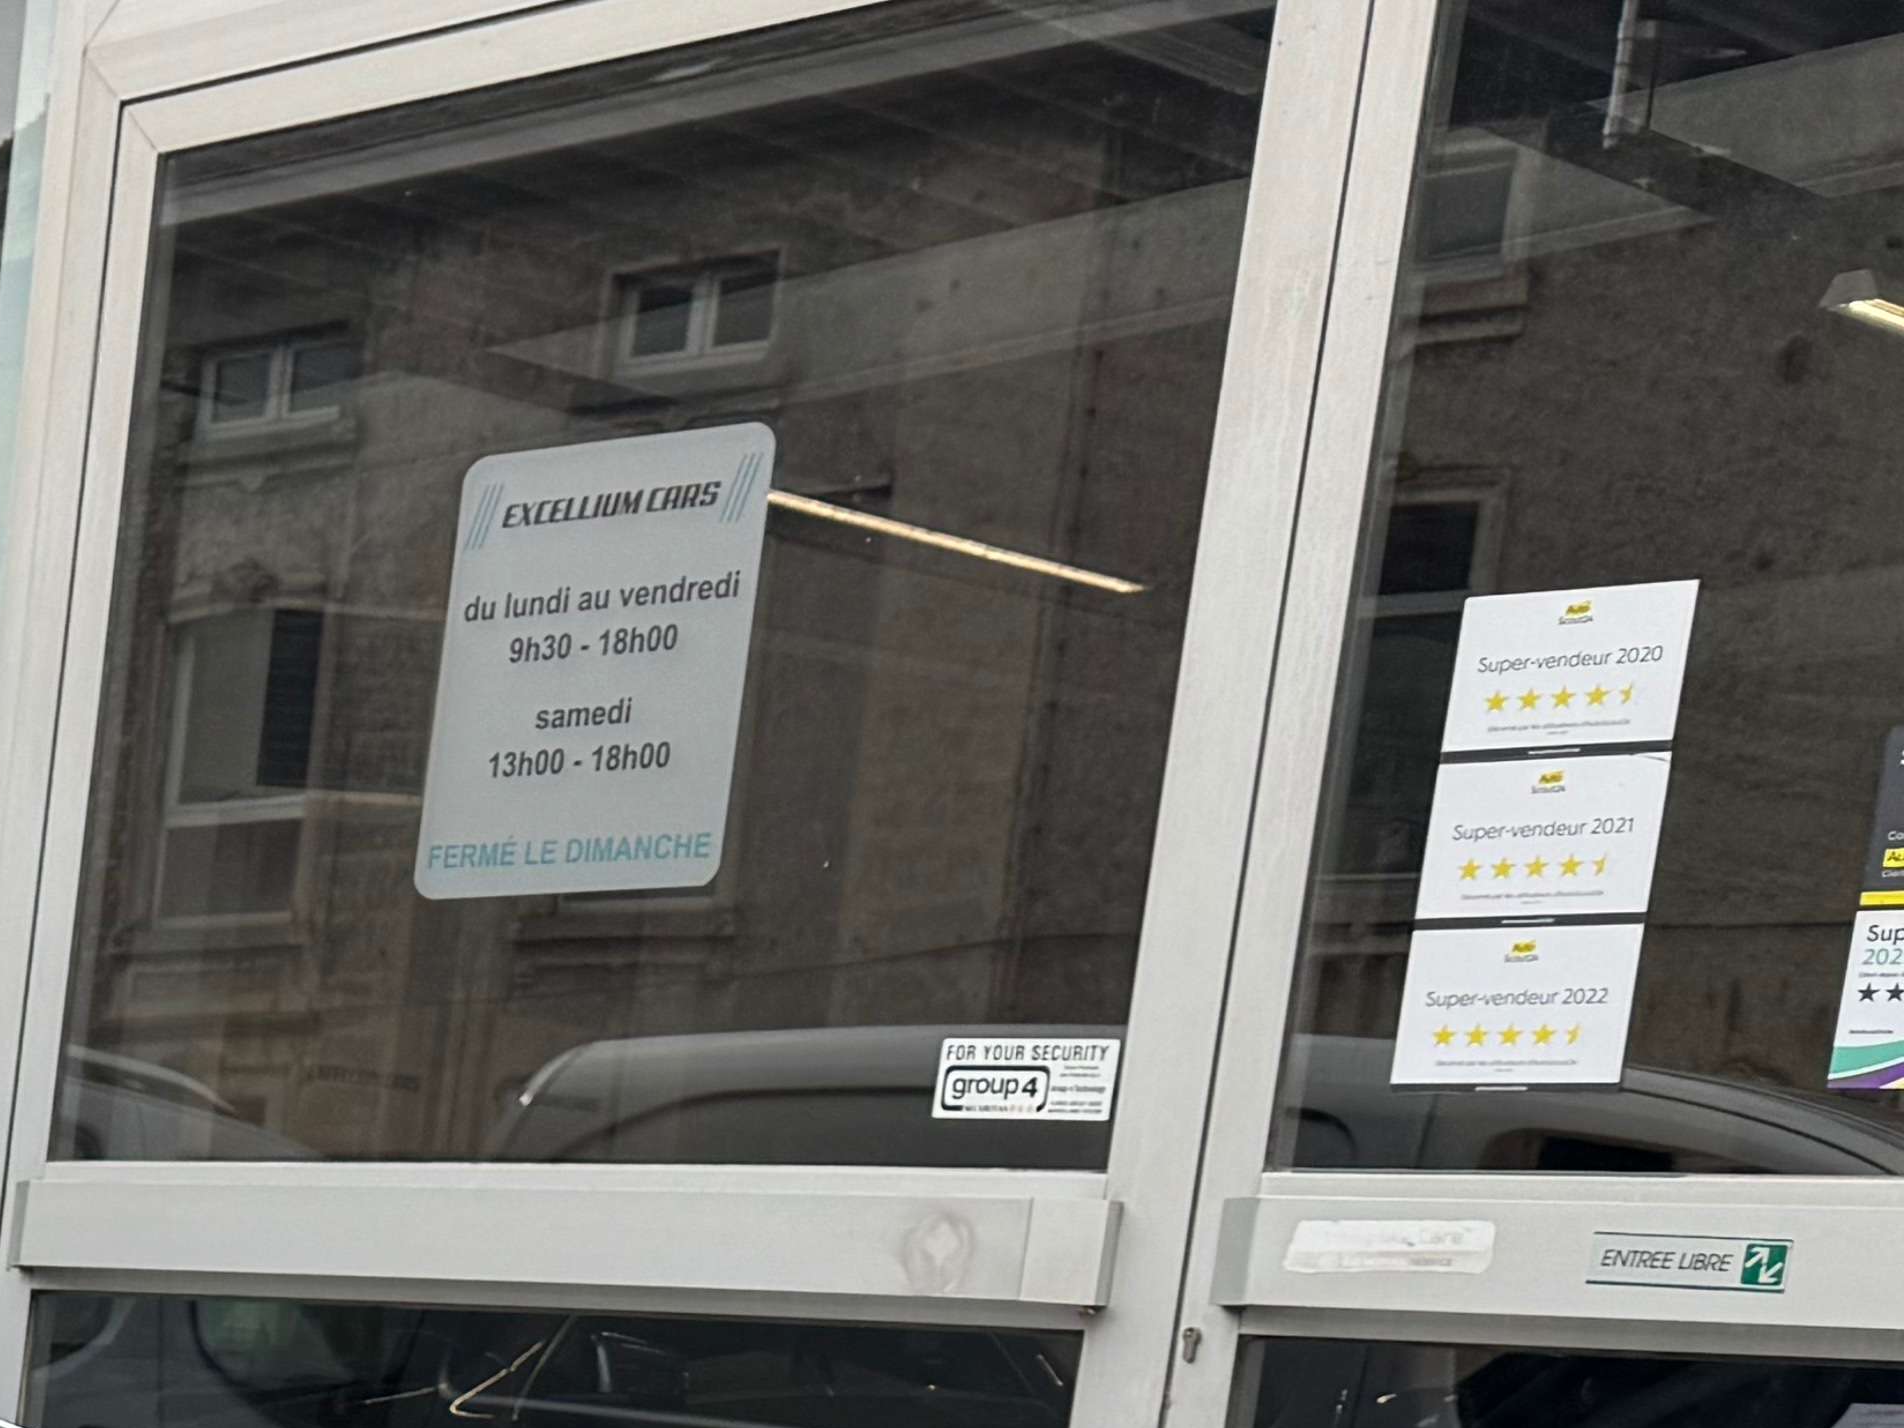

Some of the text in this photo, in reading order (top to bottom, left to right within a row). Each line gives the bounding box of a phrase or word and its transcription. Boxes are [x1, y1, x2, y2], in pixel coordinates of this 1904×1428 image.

[501, 480, 722, 529] EXCELLIUM CARS
[464, 569, 742, 623] du lundi au vendredi
[508, 633, 572, 664] 9h30
[598, 623, 678, 657] 18h00
[1477, 645, 1664, 676] Super-vendeur 2020
[534, 697, 632, 730] samedi
[488, 748, 565, 779] 13h00
[591, 741, 670, 772] 18h00
[1452, 816, 1635, 843] Super-vendeur 2021
[427, 832, 712, 869] FERMÉ LE DIMANCHE
[1425, 987, 1609, 1011] Super-vendeur 2022
[946, 1044, 1110, 1061] FOR YOUR SECURITY
[1600, 1248, 1734, 1272] ENTREE LIBRE
